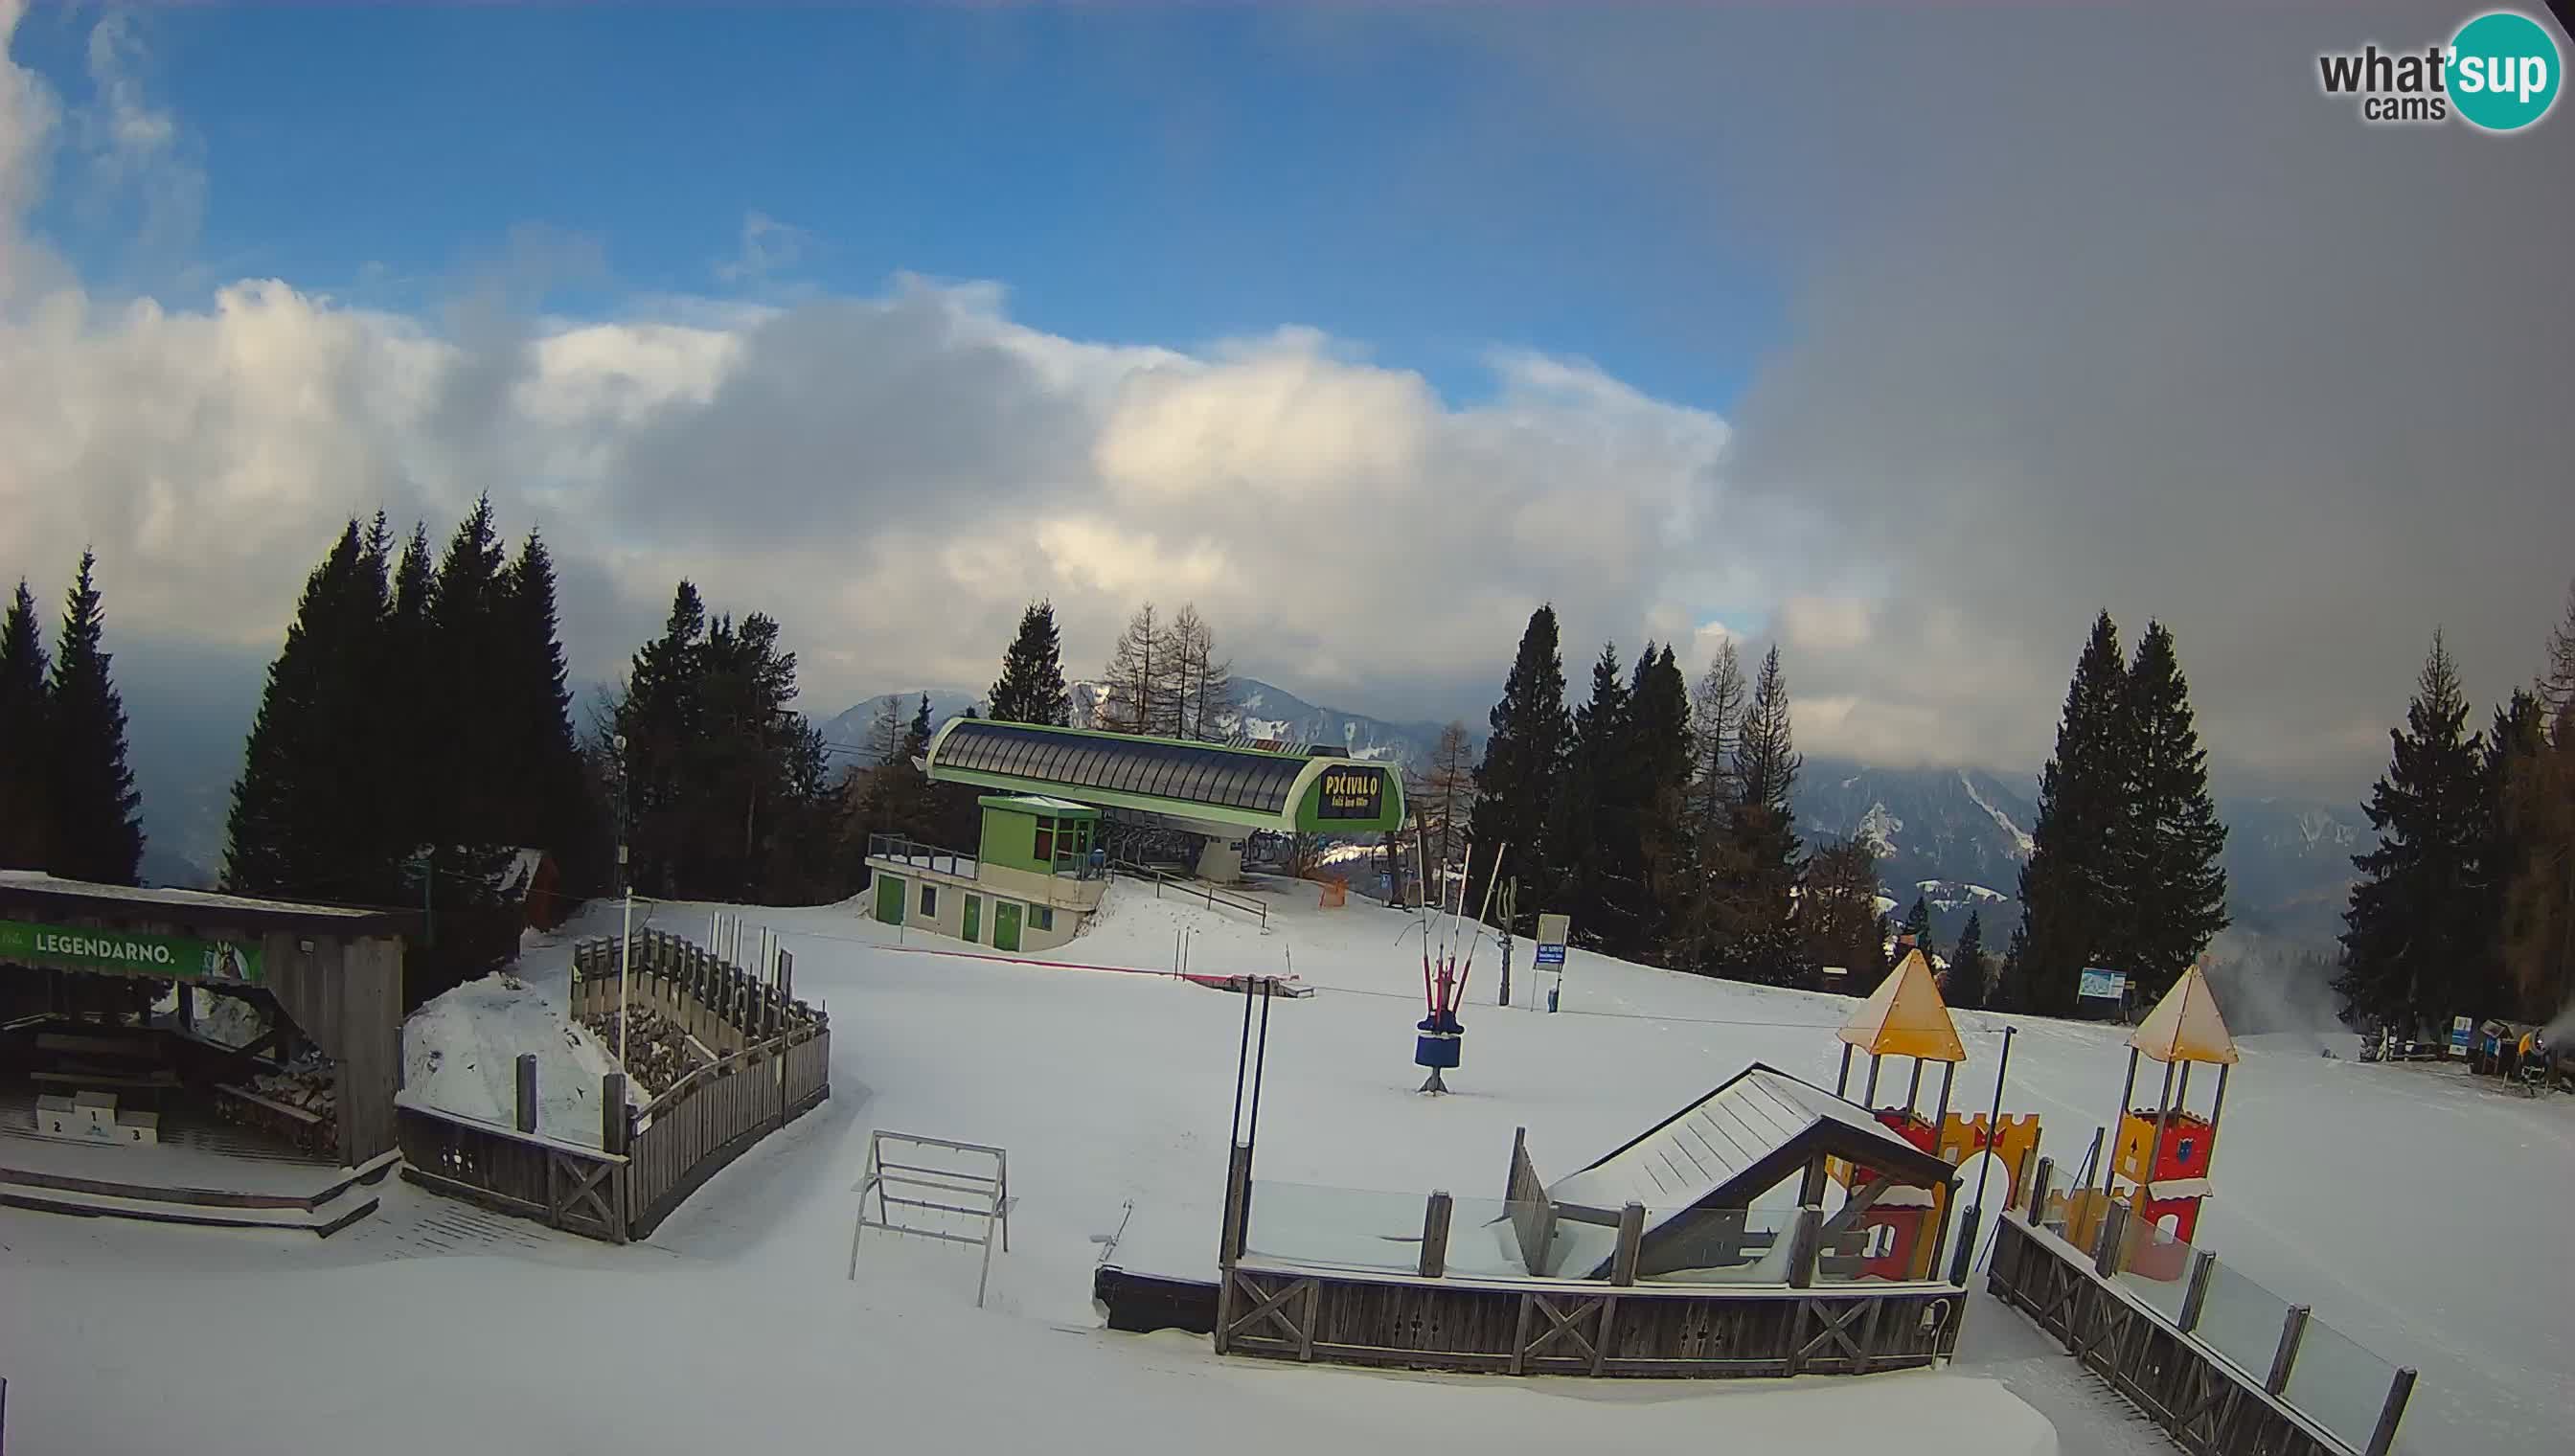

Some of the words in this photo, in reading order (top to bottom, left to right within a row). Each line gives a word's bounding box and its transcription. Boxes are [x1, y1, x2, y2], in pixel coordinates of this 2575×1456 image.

[1325, 772, 1378, 795] POČIVALO
[36, 933, 175, 965] LEGENDARNO.
[54, 1121, 62, 1132] 2
[132, 1129, 141, 1141] 3
